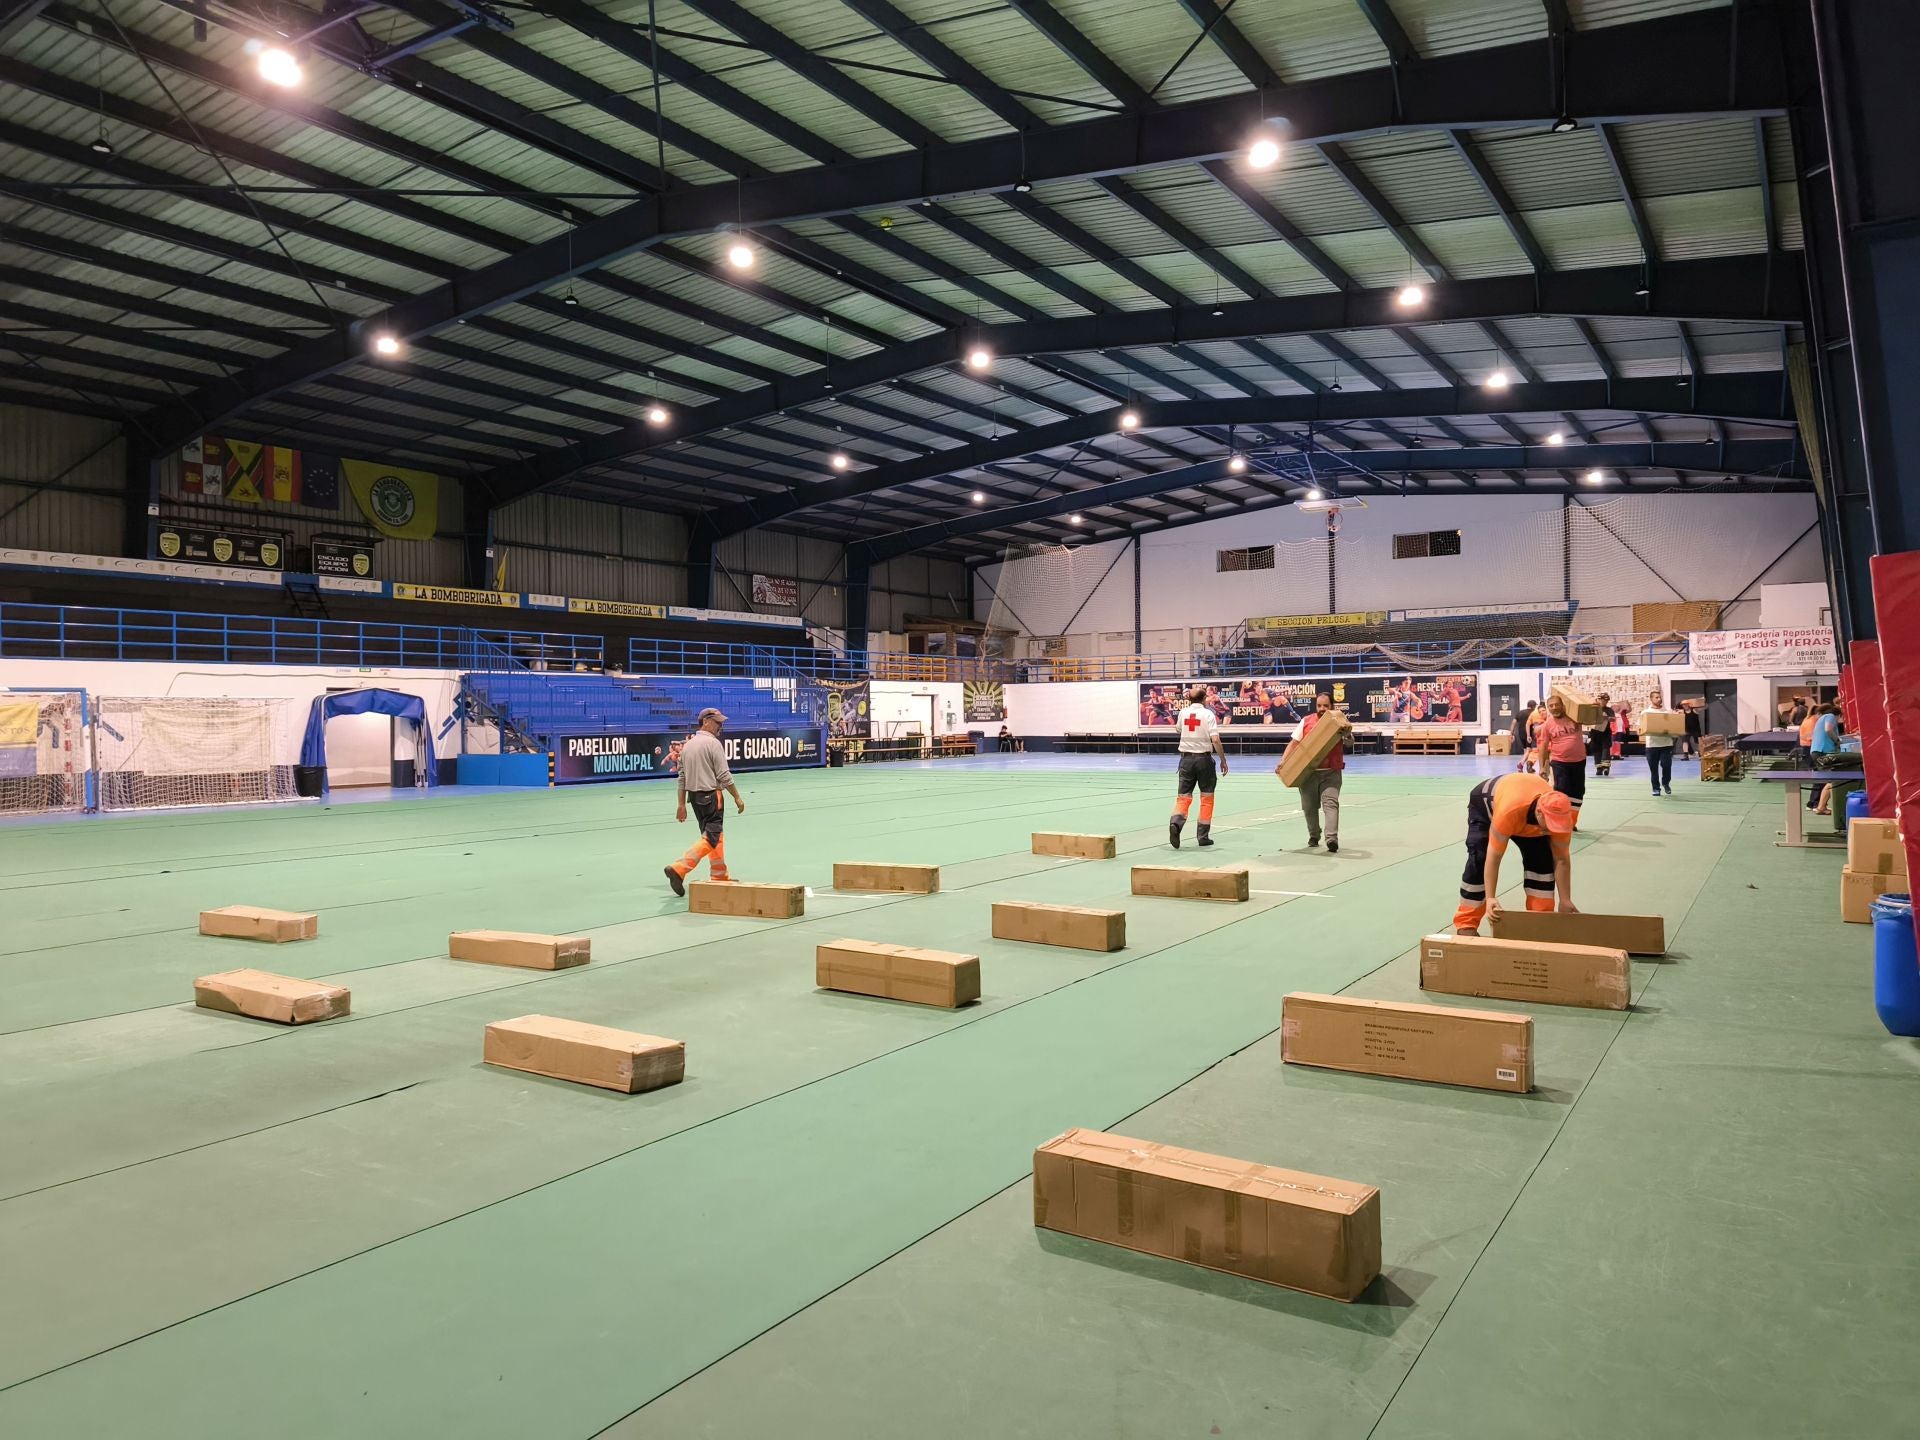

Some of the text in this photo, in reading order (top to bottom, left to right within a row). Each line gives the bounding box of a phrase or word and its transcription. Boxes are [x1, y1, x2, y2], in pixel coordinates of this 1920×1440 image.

[317, 554, 349, 562] ESCUDO
[318, 560, 348, 568] EQUIPO
[415, 587, 503, 605] LA BOMBOBRIGADA
[584, 600, 653, 617] LA BOMBOBRIGADA
[1277, 615, 1351, 626] SECCION PELUSA
[1782, 627, 1833, 638] Repostería
[1738, 637, 1831, 649] JESÚS HERAS
[1697, 652, 1736, 661] DEGUSTACIÓN
[1416, 682, 1446, 692] RESPET
[1233, 706, 1264, 716] RESPETO
[568, 737, 627, 757] PABELLON
[724, 739, 741, 761] DE
[743, 736, 792, 760] GUARDO
[593, 754, 654, 774] MUNICIPAL
